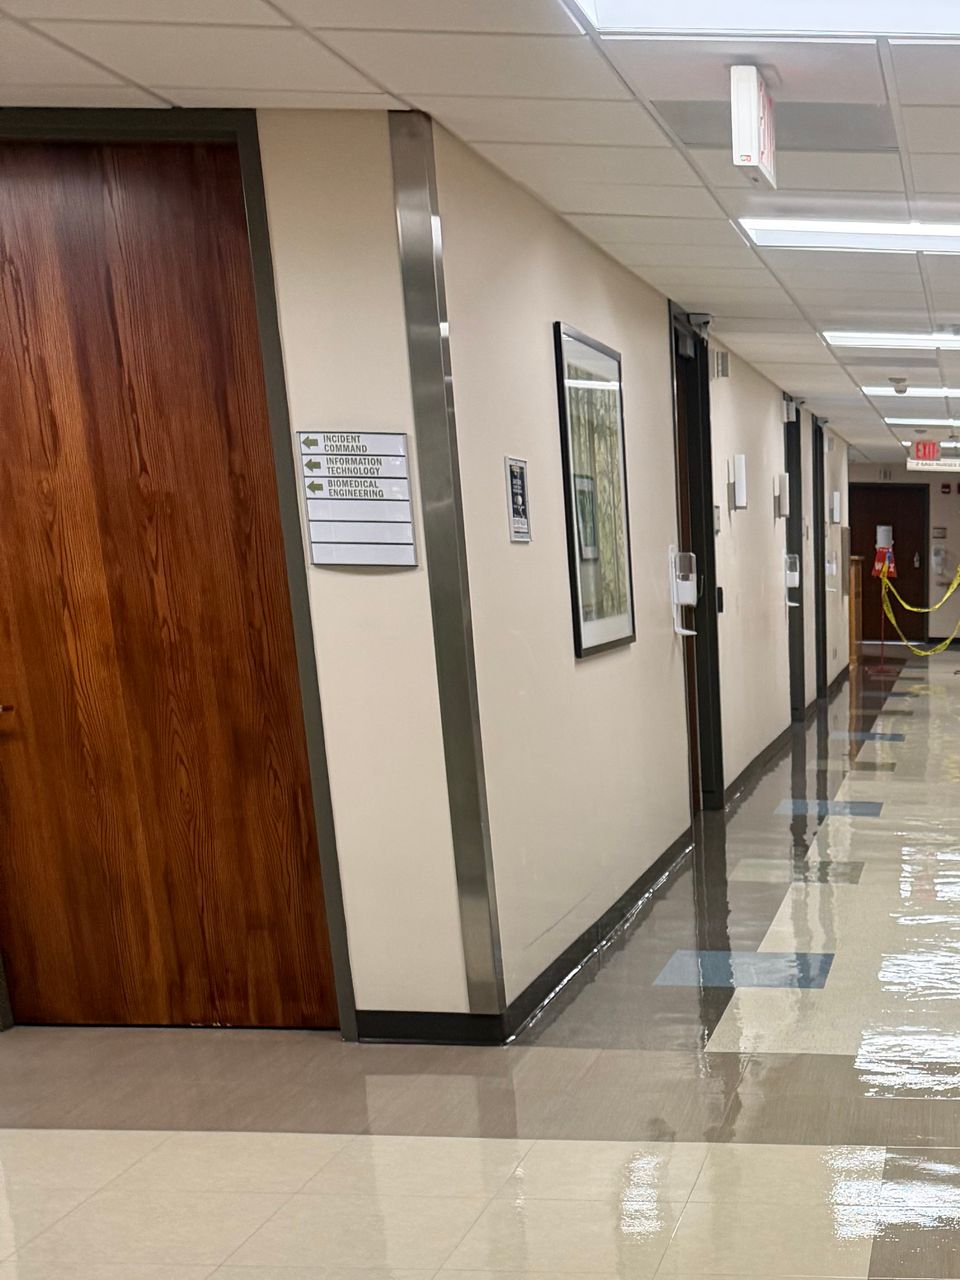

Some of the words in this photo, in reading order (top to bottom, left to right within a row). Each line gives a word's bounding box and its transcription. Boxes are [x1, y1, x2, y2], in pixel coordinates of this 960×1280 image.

[323, 434, 361, 443] INCIDENT
[324, 444, 368, 453] COMMAND
[916, 441, 937, 459] EXIT
[326, 457, 383, 466] INFORMATION
[326, 466, 381, 476] TECHNOLOGY
[327, 479, 379, 489] BIOMEDICAL
[328, 488, 384, 498] ENGINEERING
